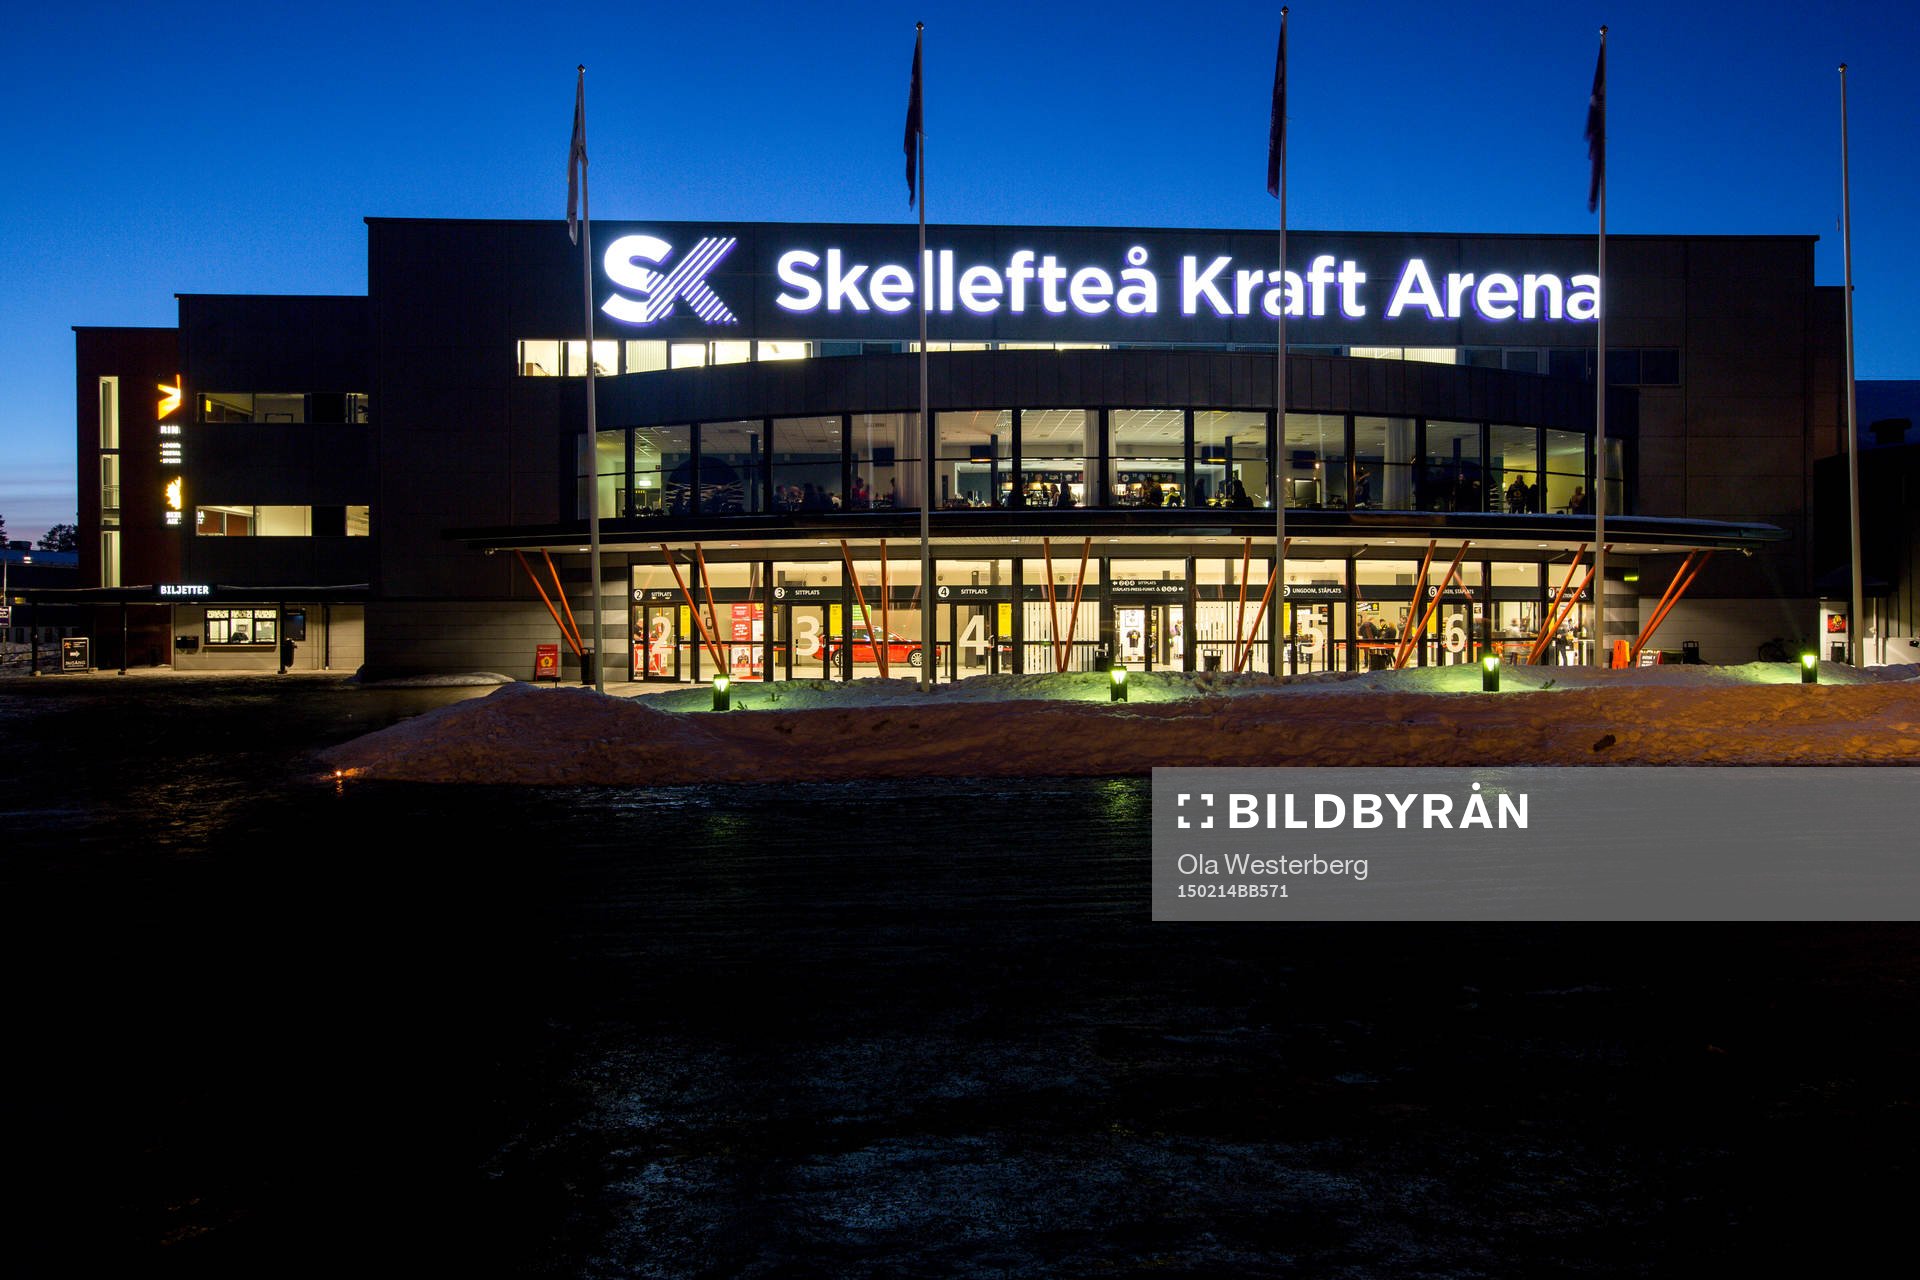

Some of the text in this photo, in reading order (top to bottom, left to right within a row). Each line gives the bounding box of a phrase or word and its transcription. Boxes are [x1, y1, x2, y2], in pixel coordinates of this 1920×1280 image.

[775, 246, 1601, 320] Skellefteå Kraft Arena
[160, 585, 209, 595] BILJETTER
[635, 590, 643, 599] 2
[775, 588, 784, 598] 3
[939, 587, 949, 597] 4
[1318, 586, 1342, 594] STÅPLATS
[1429, 586, 1436, 597] 6
[651, 616, 673, 654] 2
[796, 615, 821, 657] 3
[959, 614, 989, 656] 4
[1300, 613, 1324, 654] 5
[1445, 613, 1466, 653] 6
